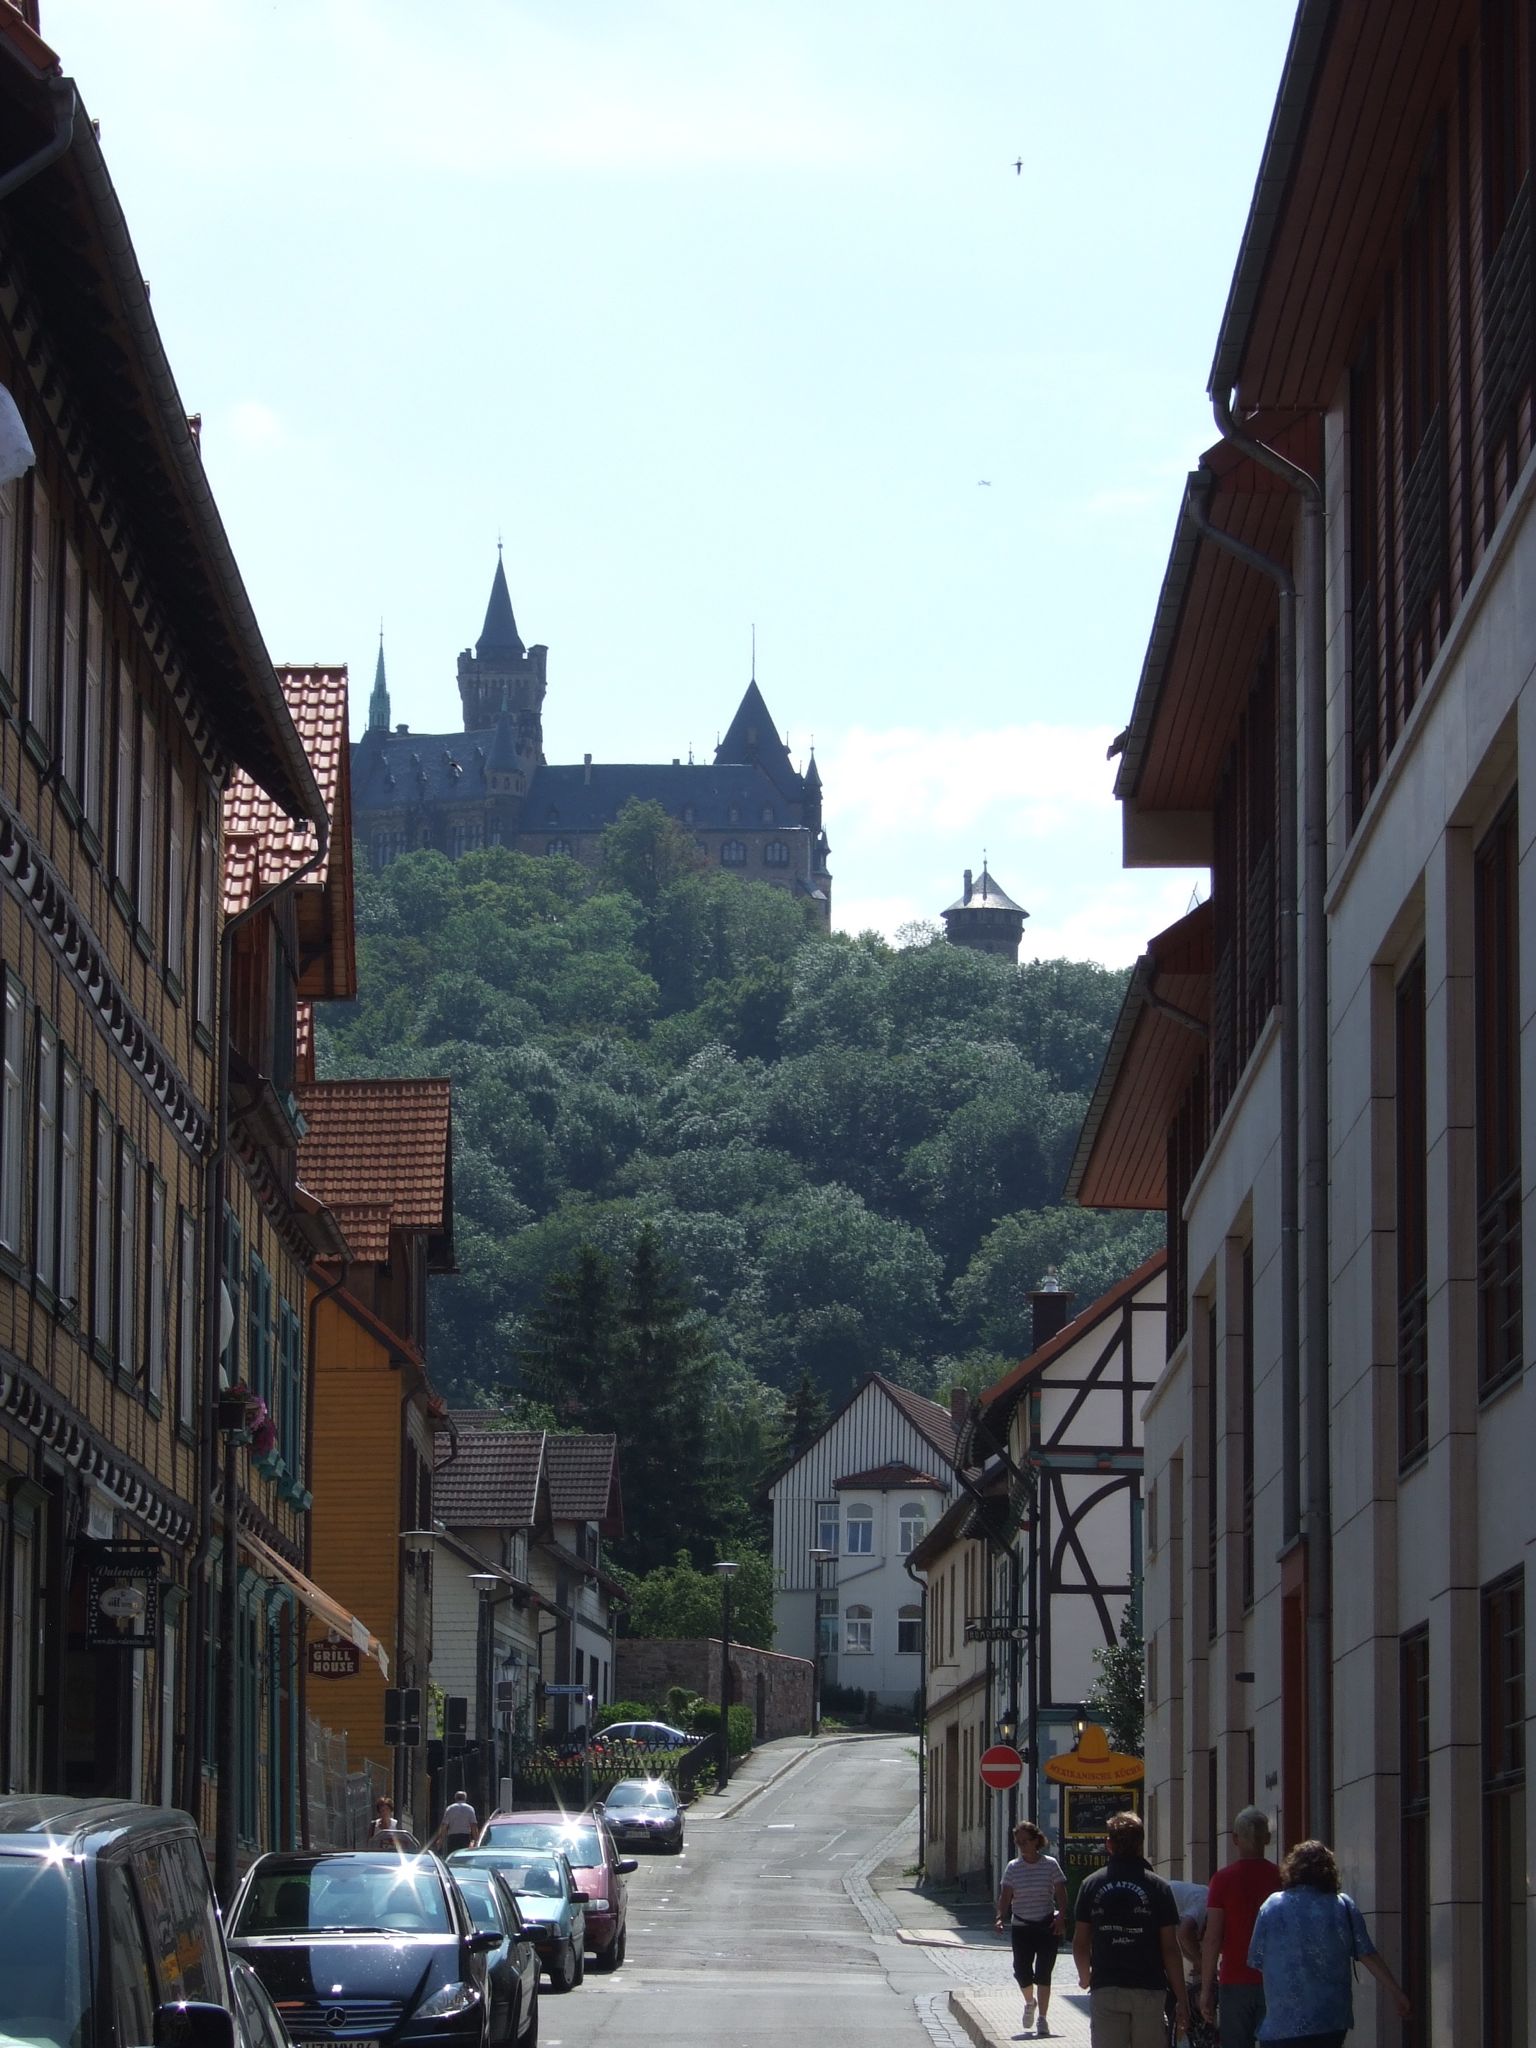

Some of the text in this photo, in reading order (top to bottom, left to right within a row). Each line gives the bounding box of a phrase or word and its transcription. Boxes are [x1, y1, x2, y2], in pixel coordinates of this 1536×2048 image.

[313, 1651, 351, 1661] GRILL
[313, 1662, 354, 1672] HOUSE
[1048, 1761, 1143, 1780] MEXIKANISCHE KÜCHE
